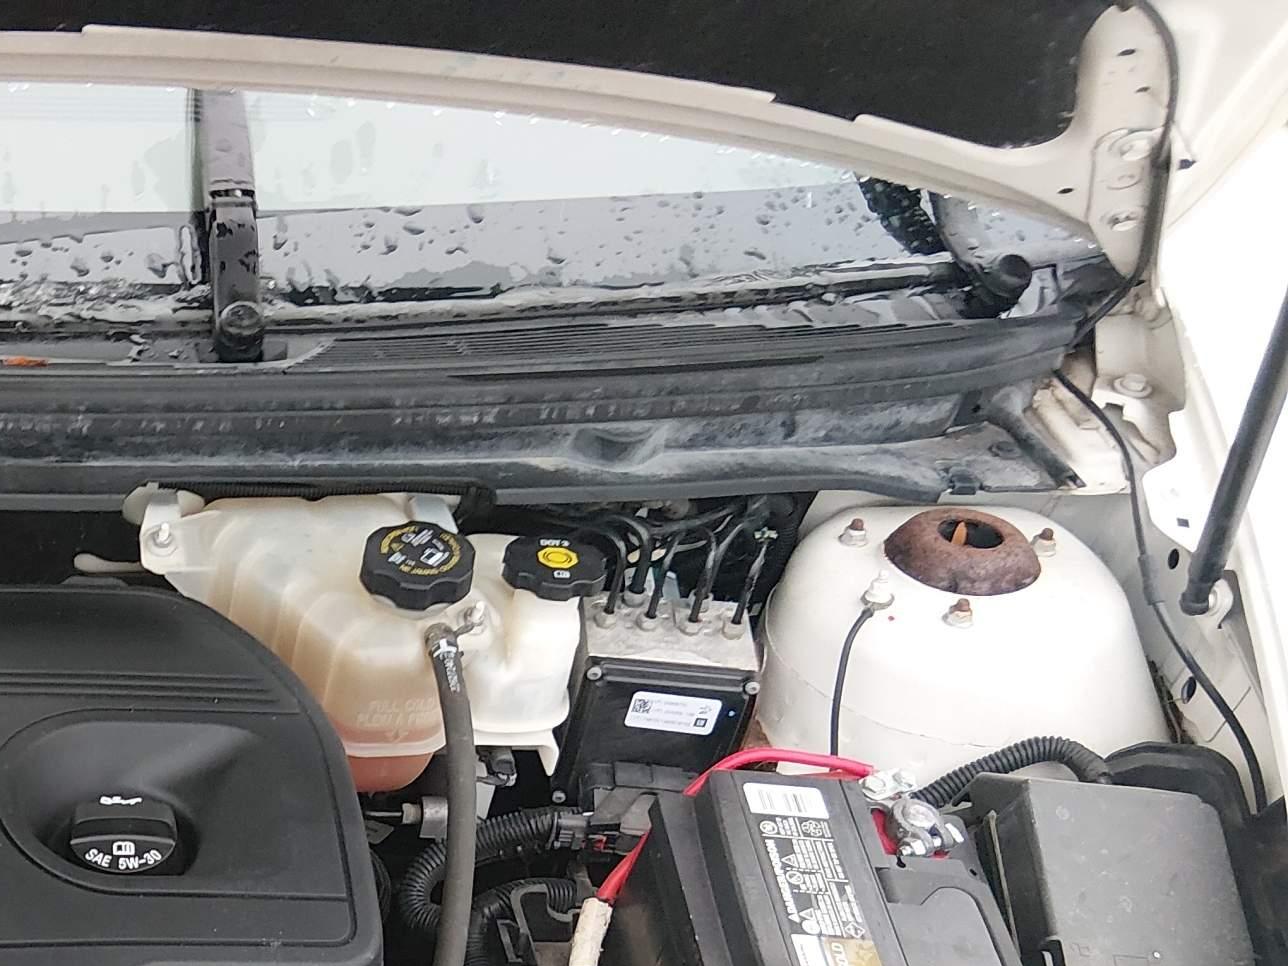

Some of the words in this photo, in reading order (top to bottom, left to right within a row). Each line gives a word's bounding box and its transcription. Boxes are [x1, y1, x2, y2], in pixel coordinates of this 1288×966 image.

[539, 538, 560, 547] DOT
[85, 848, 113, 867] SAE
[118, 849, 162, 870] 5W-30
